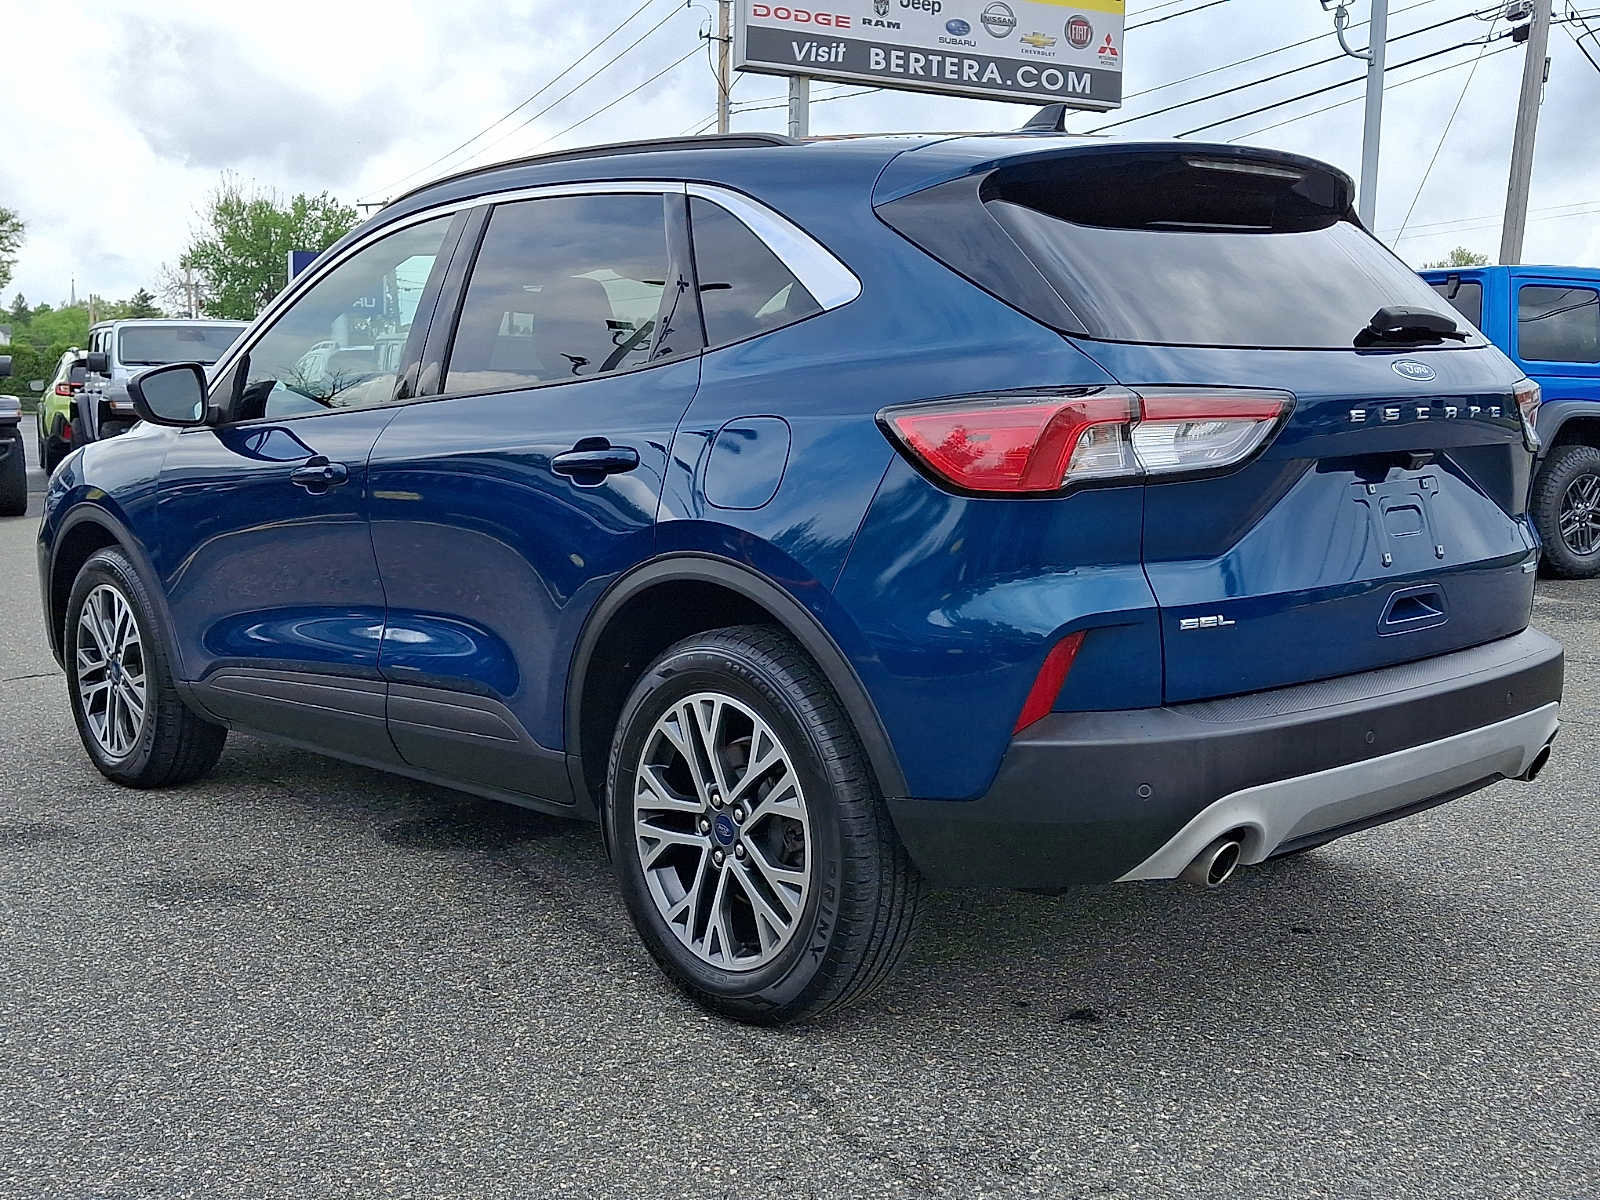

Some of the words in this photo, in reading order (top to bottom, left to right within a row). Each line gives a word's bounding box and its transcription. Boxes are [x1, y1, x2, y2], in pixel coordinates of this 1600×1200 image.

[900, 0, 942, 15] Jeep
[753, 4, 851, 29] DODGE
[862, 17, 901, 30] RAM
[983, 14, 1014, 25] NISSAN
[1071, 24, 1089, 41] FIAT
[938, 36, 977, 48] SUBARU
[1021, 48, 1056, 57] CHEVROLET
[791, 41, 847, 63] Visit
[869, 47, 1092, 95] BERTERA.COM
[1350, 405, 1501, 423] ESCAPE
[1180, 614, 1236, 631] SEL
